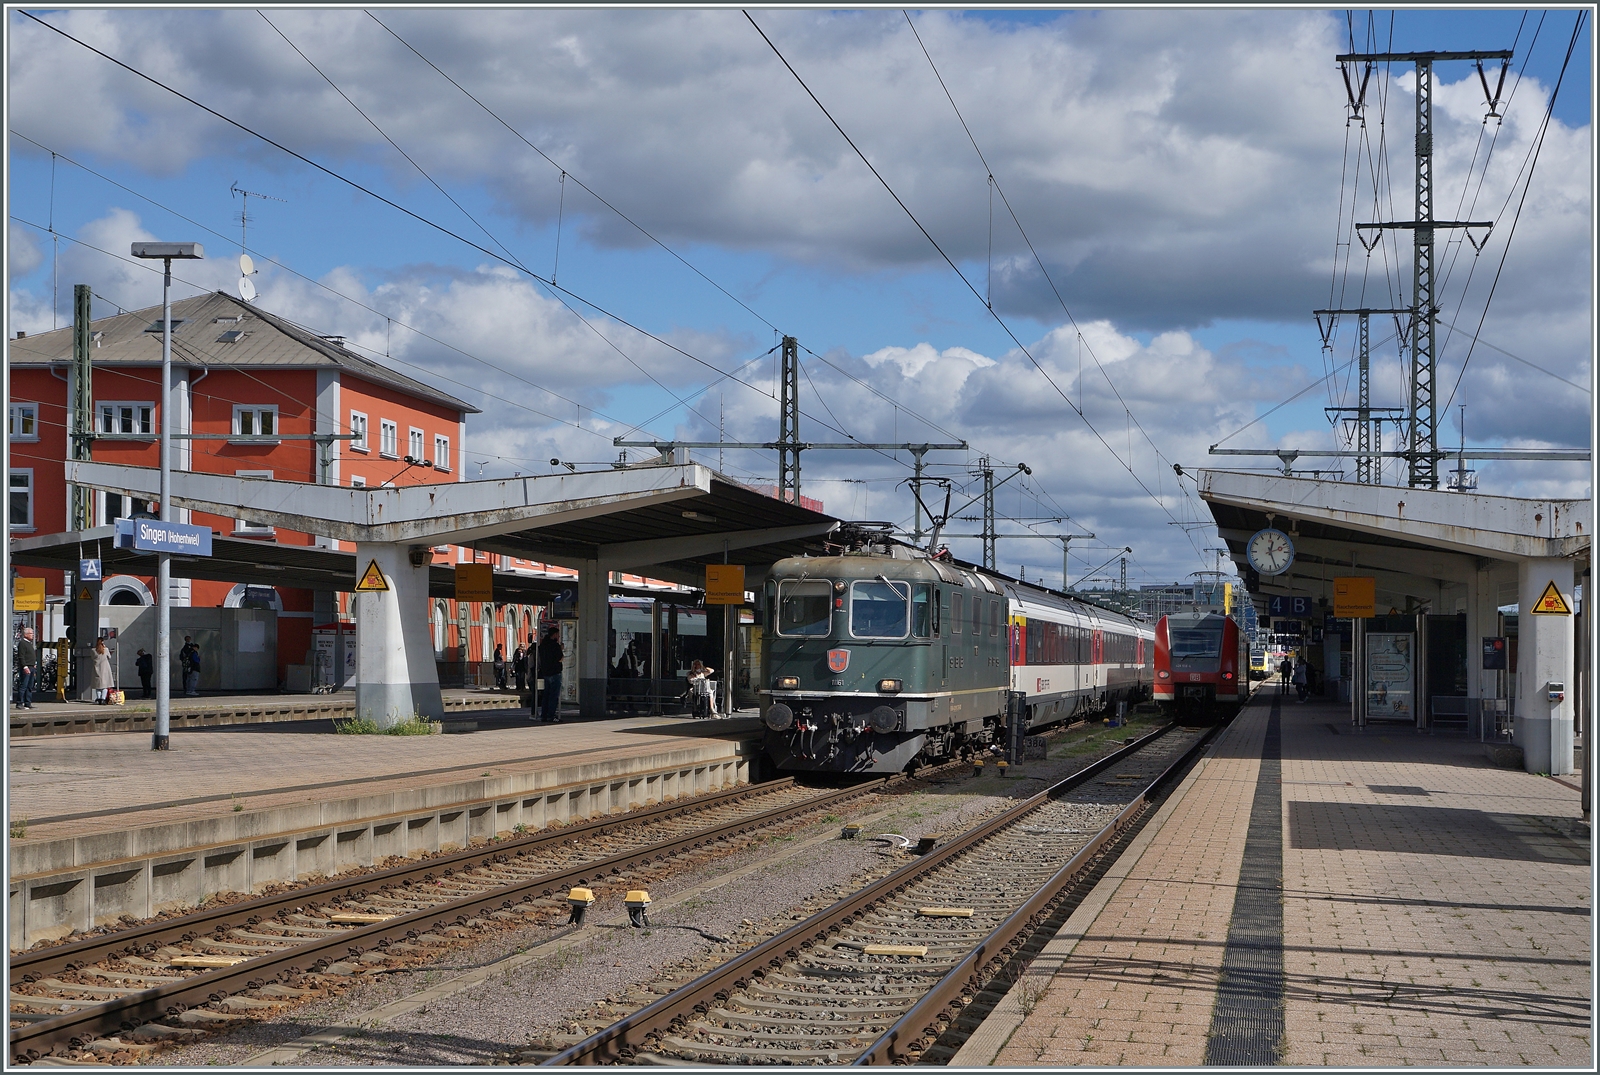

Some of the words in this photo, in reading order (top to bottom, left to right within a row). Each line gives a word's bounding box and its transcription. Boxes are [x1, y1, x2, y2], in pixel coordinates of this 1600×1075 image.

[140, 523, 167, 545] Singen
[168, 529, 200, 547] (Hohentwiel)
[85, 560, 99, 576] A
[563, 589, 572, 602] 2
[1271, 597, 1282, 612] 4
[1294, 598, 1305, 613] B
[1276, 622, 1282, 631] 4
[1289, 622, 1298, 632] C
[949, 656, 964, 668] SBB
[987, 656, 1000, 667] FFS
[1190, 673, 1200, 681] DB
